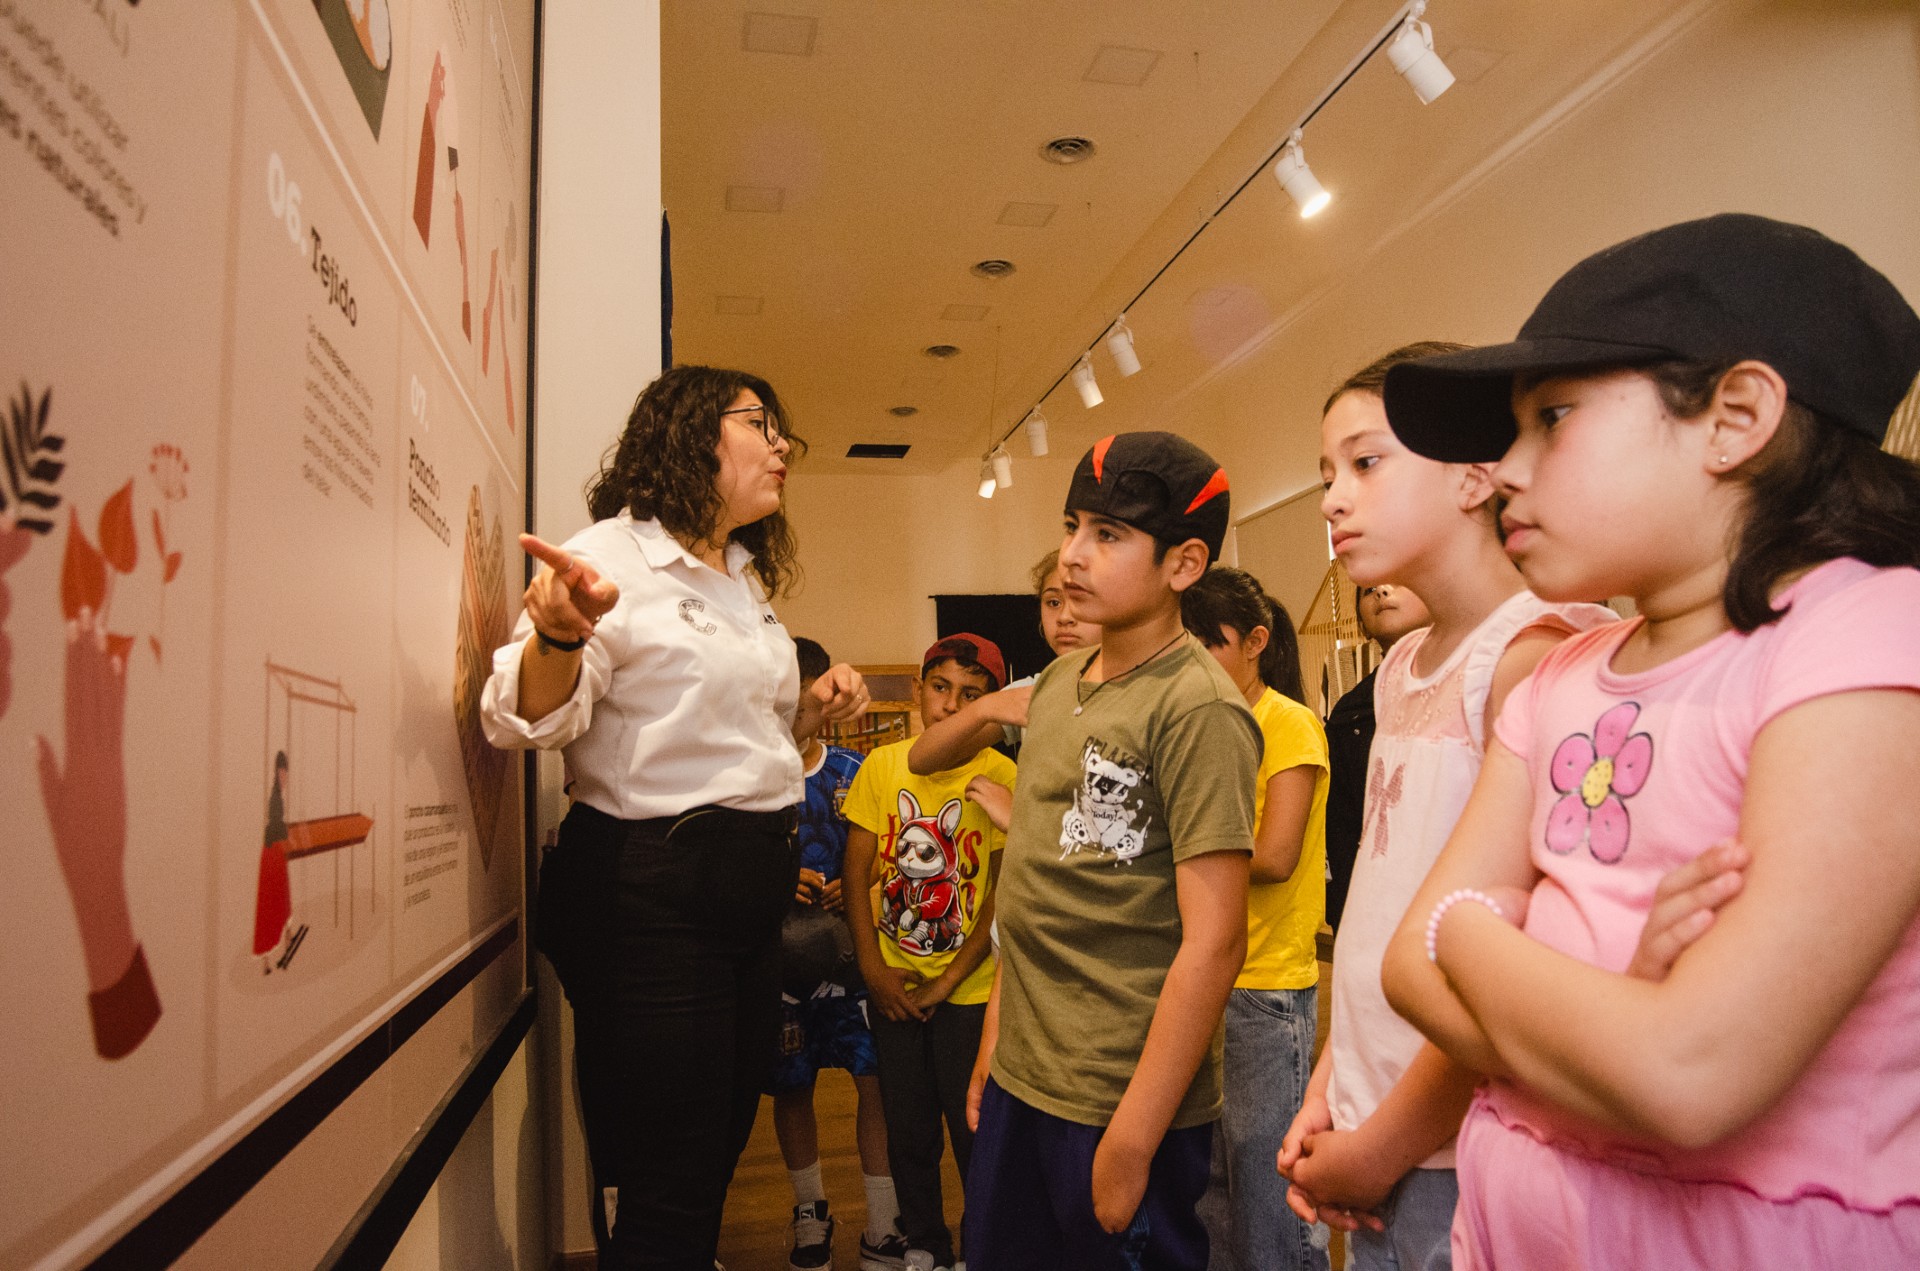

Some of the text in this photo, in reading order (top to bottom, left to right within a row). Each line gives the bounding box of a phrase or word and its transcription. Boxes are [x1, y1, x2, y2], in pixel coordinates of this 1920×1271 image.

[267, 152, 308, 257] 06.
[310, 224, 358, 328] Tejido
[408, 436, 441, 501] Poncho
[408, 475, 451, 548] terminado
